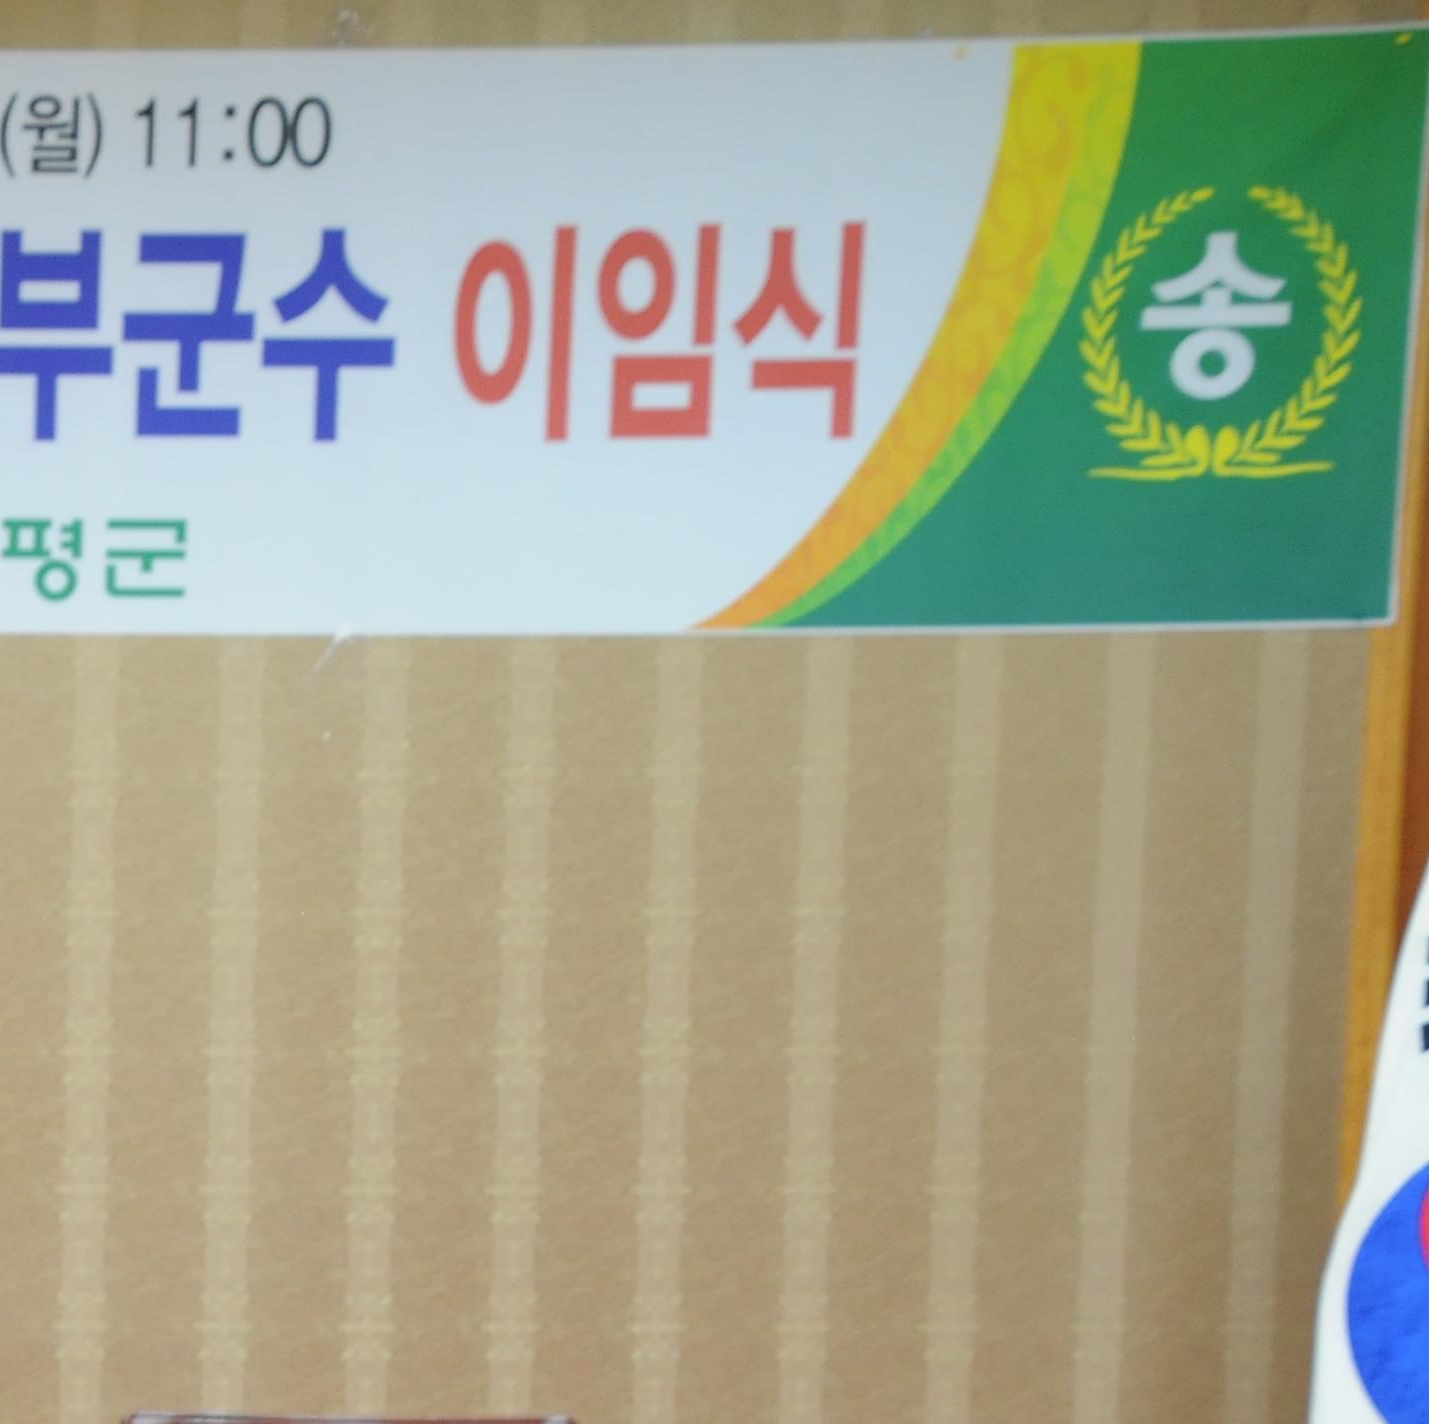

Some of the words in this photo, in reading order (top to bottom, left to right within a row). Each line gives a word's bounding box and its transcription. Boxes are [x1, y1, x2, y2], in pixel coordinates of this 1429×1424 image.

[137, 96, 334, 170] 11:00
[453, 220, 868, 444] 이임식
[1140, 230, 1293, 401] 송
